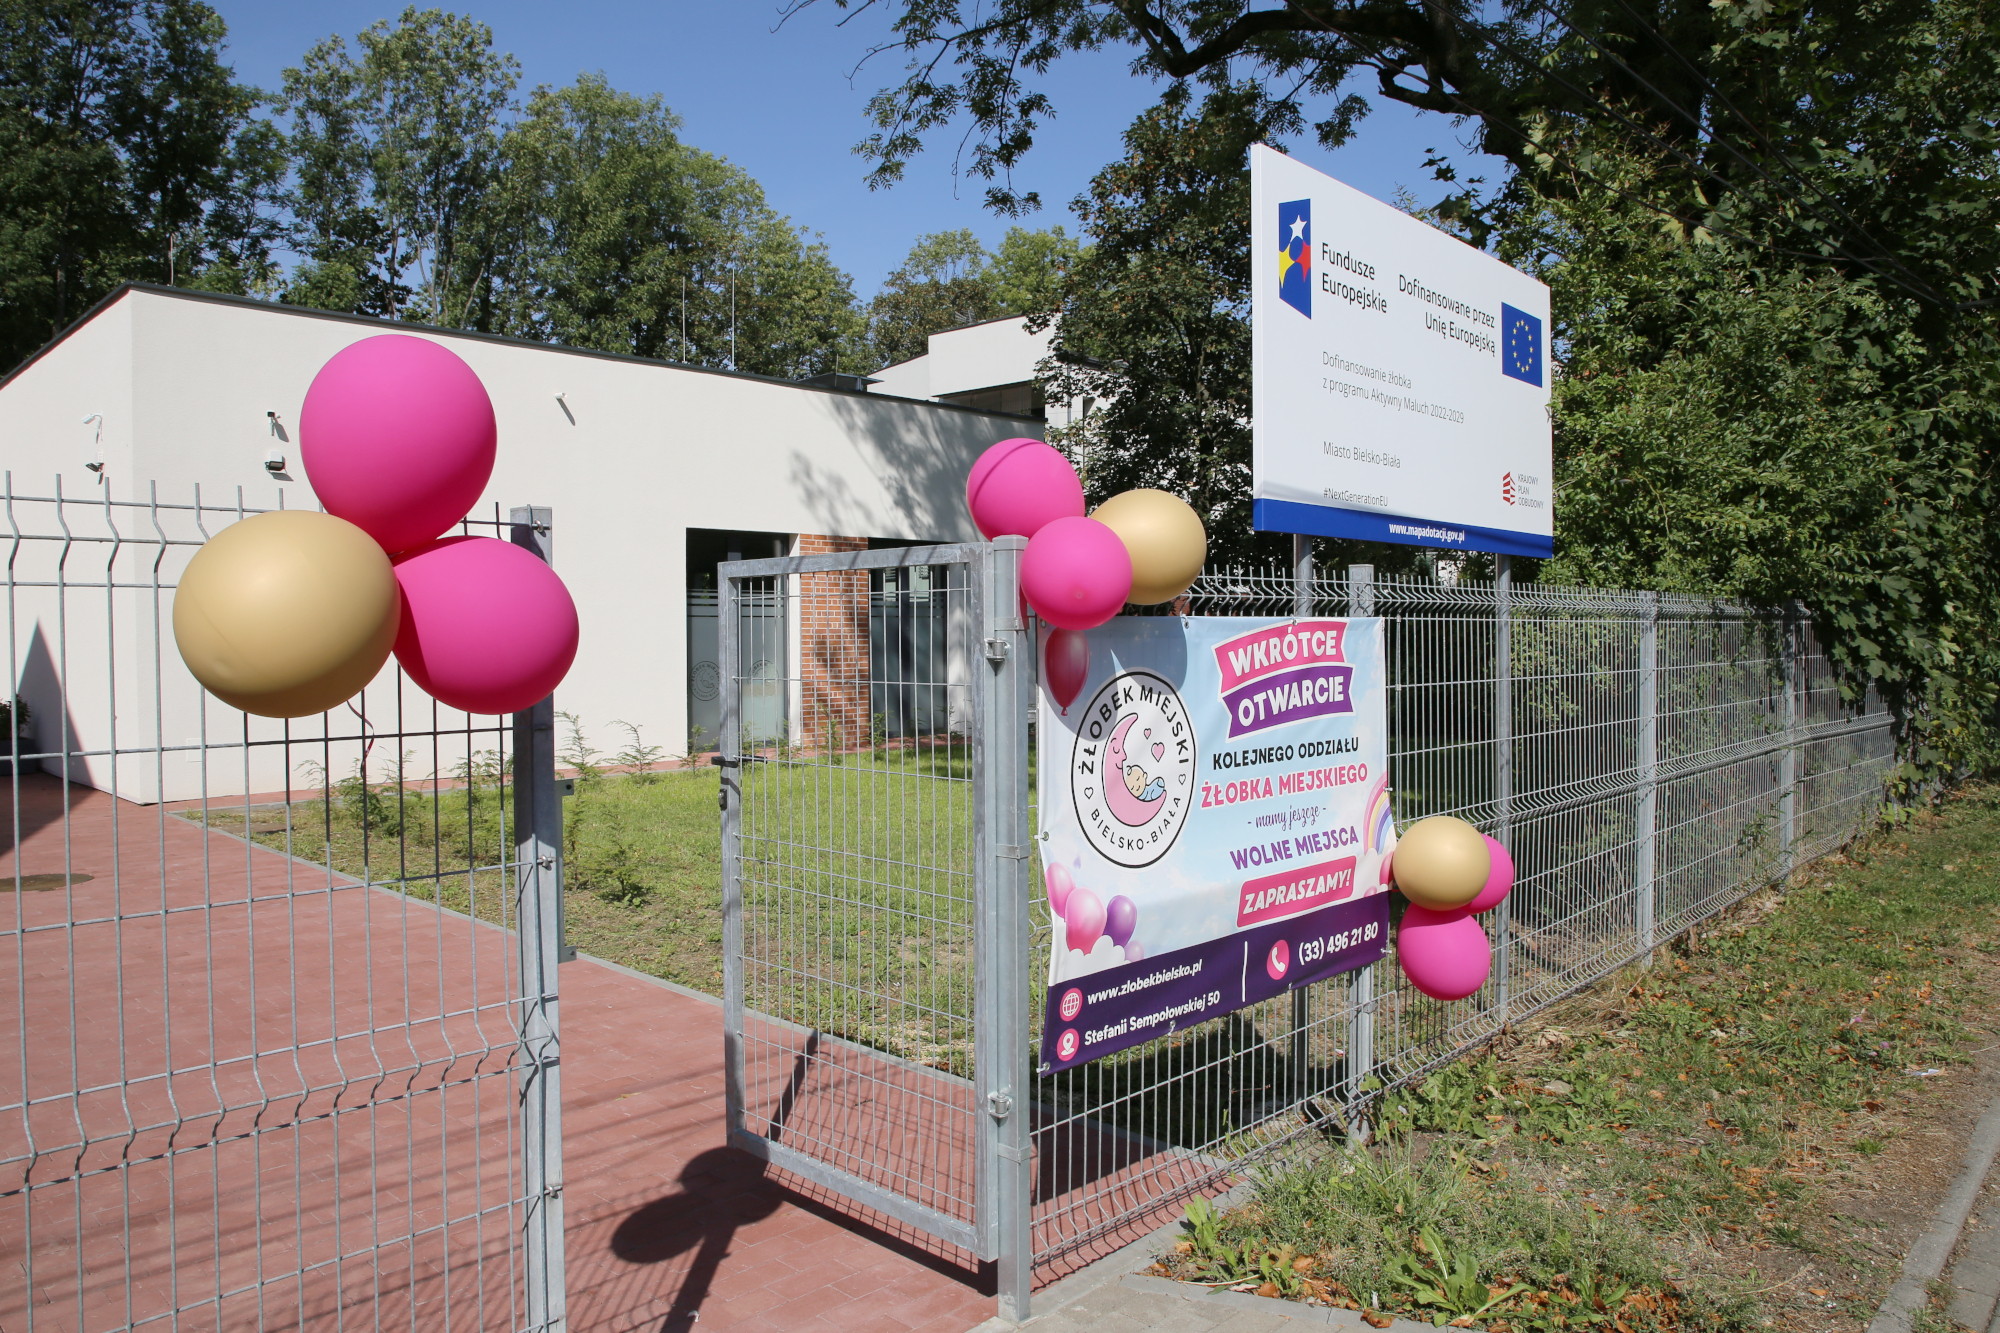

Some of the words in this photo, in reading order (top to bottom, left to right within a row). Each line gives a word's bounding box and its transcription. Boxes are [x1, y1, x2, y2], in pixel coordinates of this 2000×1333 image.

[1322, 242, 1375, 280] Fundusze
[1322, 272, 1387, 313] Europejskie
[1399, 274, 1470, 318] Dofinansowane
[1473, 308, 1495, 329] przez
[1425, 312, 1447, 339] Unię
[1450, 321, 1495, 357] Europejską
[1322, 351, 1387, 382] Dofinansowanie
[1388, 371, 1412, 389] żłobka
[1322, 378, 1328, 389] z
[1329, 379, 1369, 399] programu
[1371, 388, 1402, 411] Aktywny
[1403, 397, 1429, 415] Maluch
[1430, 403, 1465, 424] 2022-2029
[1323, 441, 1351, 459] Miasto
[1353, 447, 1400, 468] Bielsko-Biała
[1323, 487, 1388, 507] #NextGenerationEU
[1518, 473, 1538, 485] KRAJOWY
[1518, 485, 1529, 495] PLAN
[1389, 523, 1465, 544] www.mapadotacji.gov.pl
[1228, 626, 1337, 677] WKRÓTCE
[1238, 676, 1344, 727] OTWARCIE
[1078, 685, 1134, 775] ŻŁOBEK
[1140, 684, 1189, 764] MIEJSKI
[1213, 745, 1294, 770] KOLEJNEGO
[1298, 737, 1359, 759] ODDZIAŁU
[1201, 777, 1273, 808] ŻŁOBKA
[1279, 763, 1368, 796] MIEJSKIEGO
[1091, 796, 1181, 850] BIELSKO-BIAŁA
[1255, 812, 1287, 831] mamy
[1288, 805, 1320, 830] jeszcze
[1230, 839, 1292, 870] WOLNE
[1295, 826, 1359, 856] MIEJSCA
[1243, 868, 1352, 914] ZAPRASZAMY!
[1298, 937, 1325, 965] (33)
[1326, 931, 1349, 953] 496
[1350, 926, 1362, 946] 21
[1364, 921, 1378, 941] 80
[1087, 958, 1202, 1005] www.zlobekbielsko.pl
[1084, 1019, 1127, 1045] Stefanii
[1129, 994, 1206, 1031] Sempołowskiej
[1207, 990, 1220, 1006] 50
